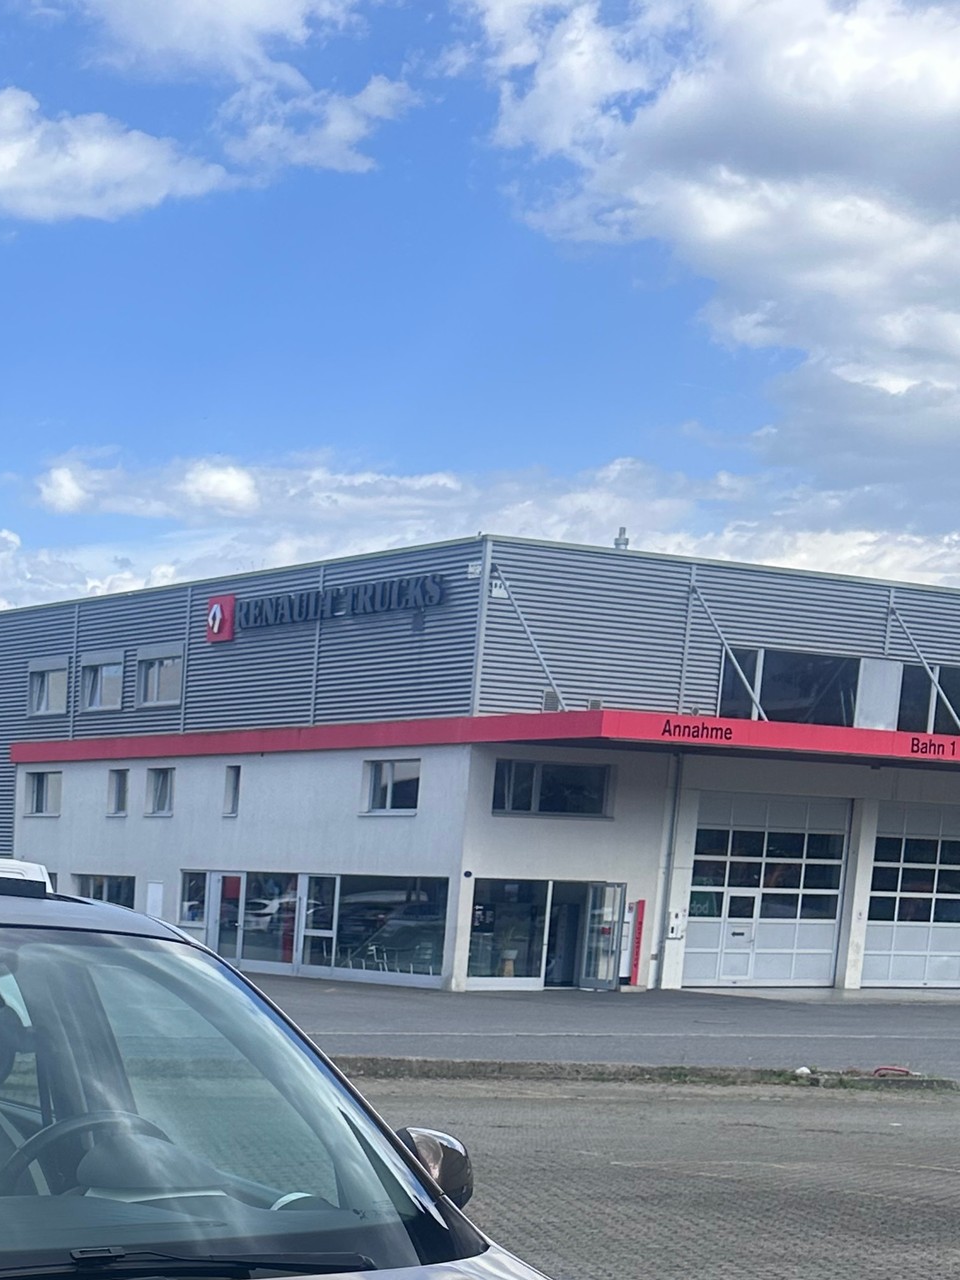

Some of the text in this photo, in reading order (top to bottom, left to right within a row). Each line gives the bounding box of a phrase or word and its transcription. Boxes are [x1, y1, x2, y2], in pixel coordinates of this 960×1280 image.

[235, 574, 443, 629] RENAULT TRUCKS
[661, 719, 733, 740] Annahme
[911, 738, 957, 756] Bahn 1
